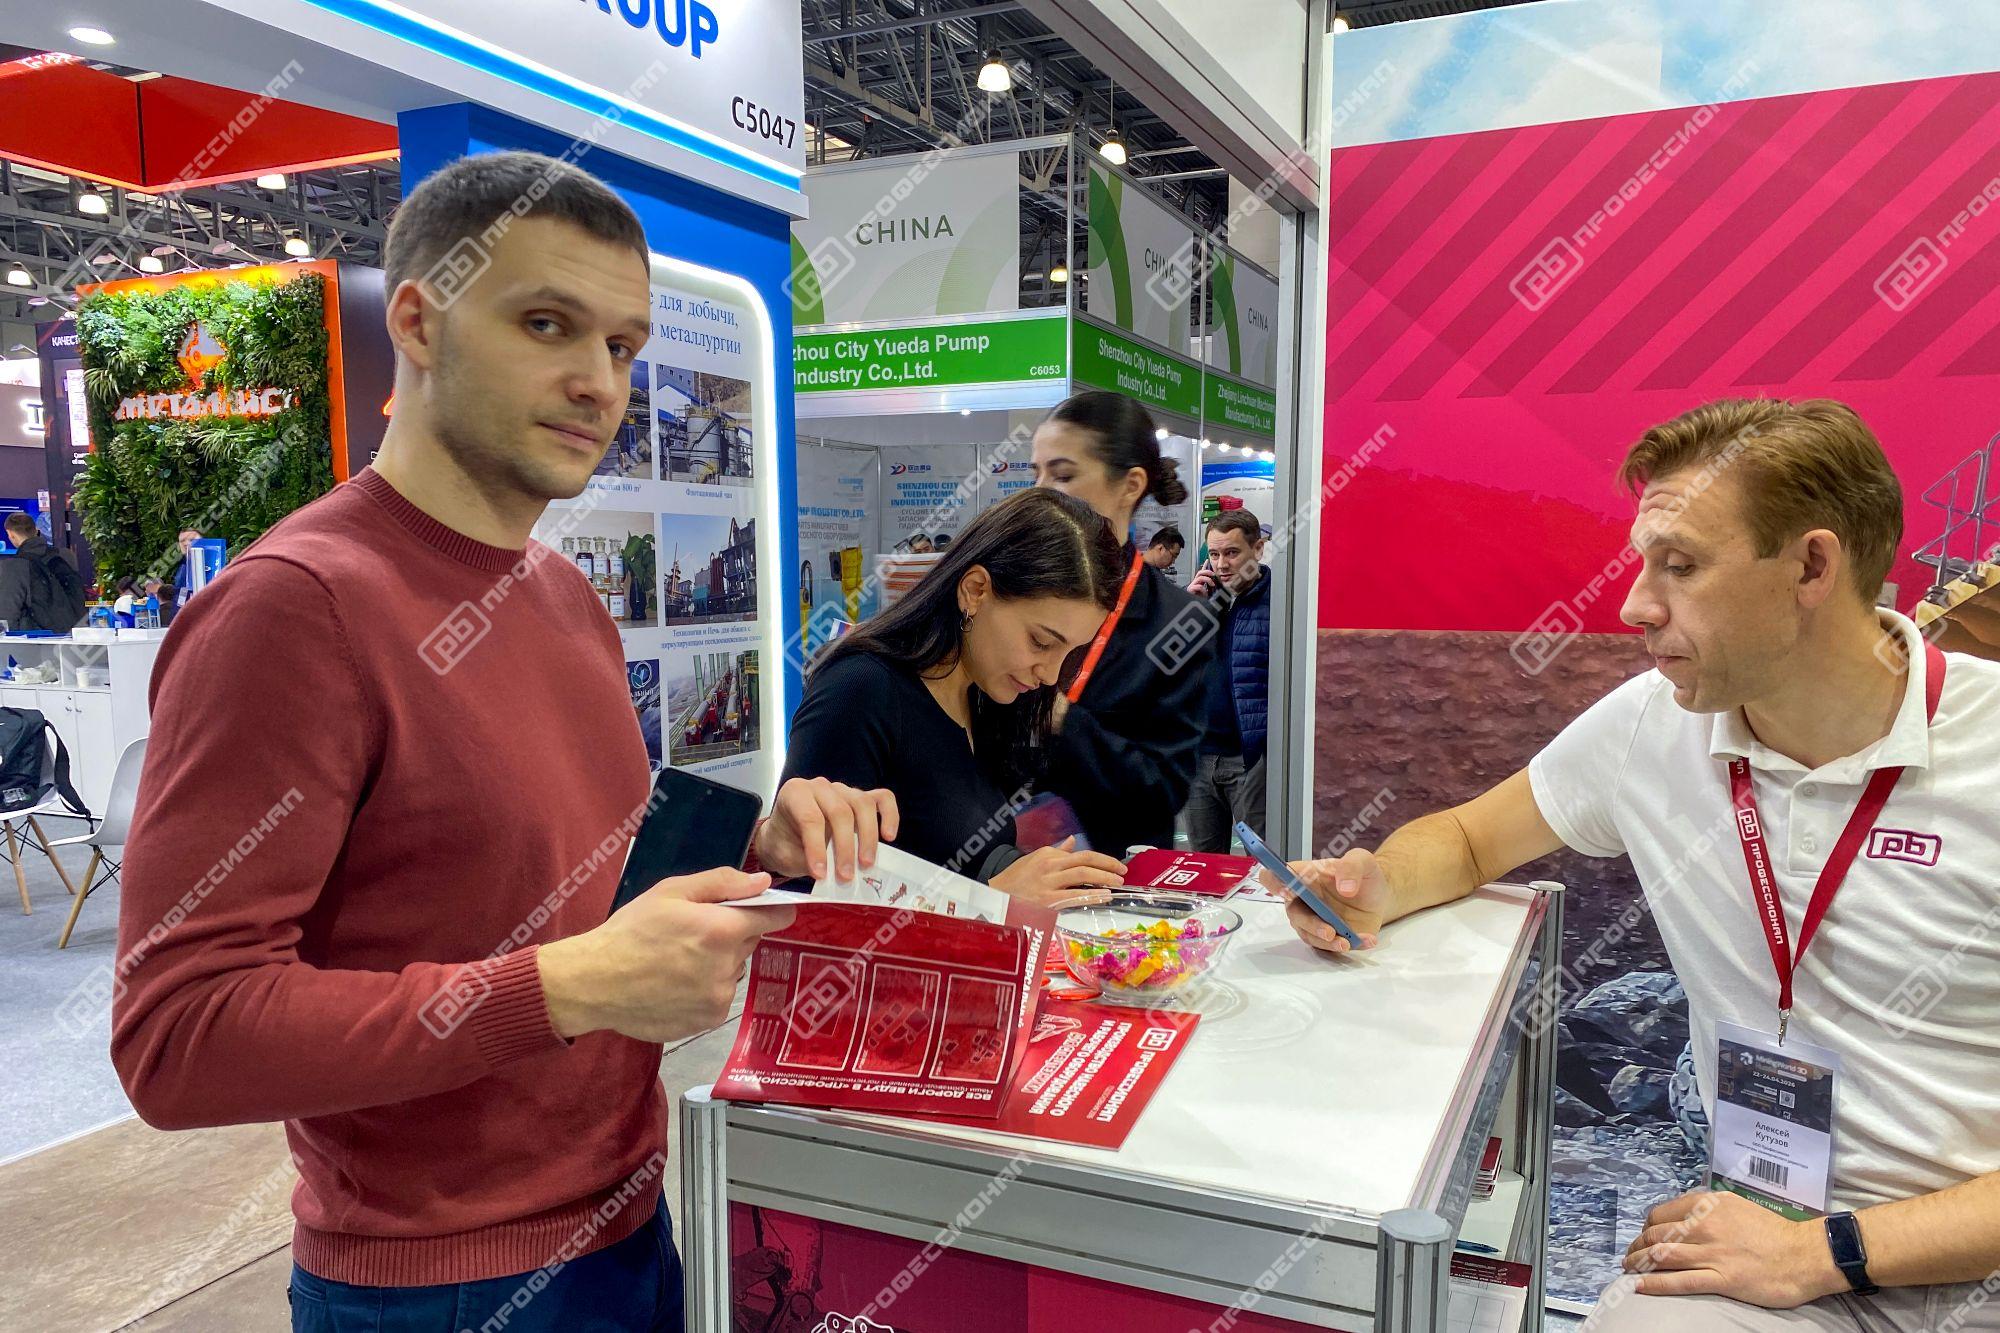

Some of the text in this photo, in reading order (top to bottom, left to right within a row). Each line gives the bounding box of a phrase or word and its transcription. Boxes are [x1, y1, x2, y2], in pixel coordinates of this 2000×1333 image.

[731, 96, 796, 149] C5047
[856, 214, 954, 245] CHINA
[1144, 248, 1175, 282] CHINA
[660, 294, 682, 312] для
[688, 301, 738, 329] добычи,
[1248, 306, 1269, 331] CHINA
[51, 334, 80, 347] КАЧЕСТ
[660, 324, 741, 354] металлургии
[792, 334, 990, 362] zhou City Yueda Pump
[793, 361, 938, 387] Industry Co.,Ltd.
[1029, 364, 1061, 376] C6053
[1098, 337, 1182, 388] Shenzhou City Yueda Pump
[1117, 368, 1144, 396] Industry
[1750, 842, 1784, 945] ПРОФЕССИОНАЛ
[852, 1083, 861, 1091] В
[863, 1084, 905, 1094] ВЕДУТ
[908, 1087, 964, 1099] ДОРОГИ
[965, 1091, 992, 1101] ВСЕ
[1096, 1051, 1156, 1122] ПРОФЕССИОНАЛ
[1755, 1121, 1790, 1138] Алексей
[1755, 1131, 1789, 1148] Кутузов
[1746, 1194, 1783, 1213] УЧАСТНИК
